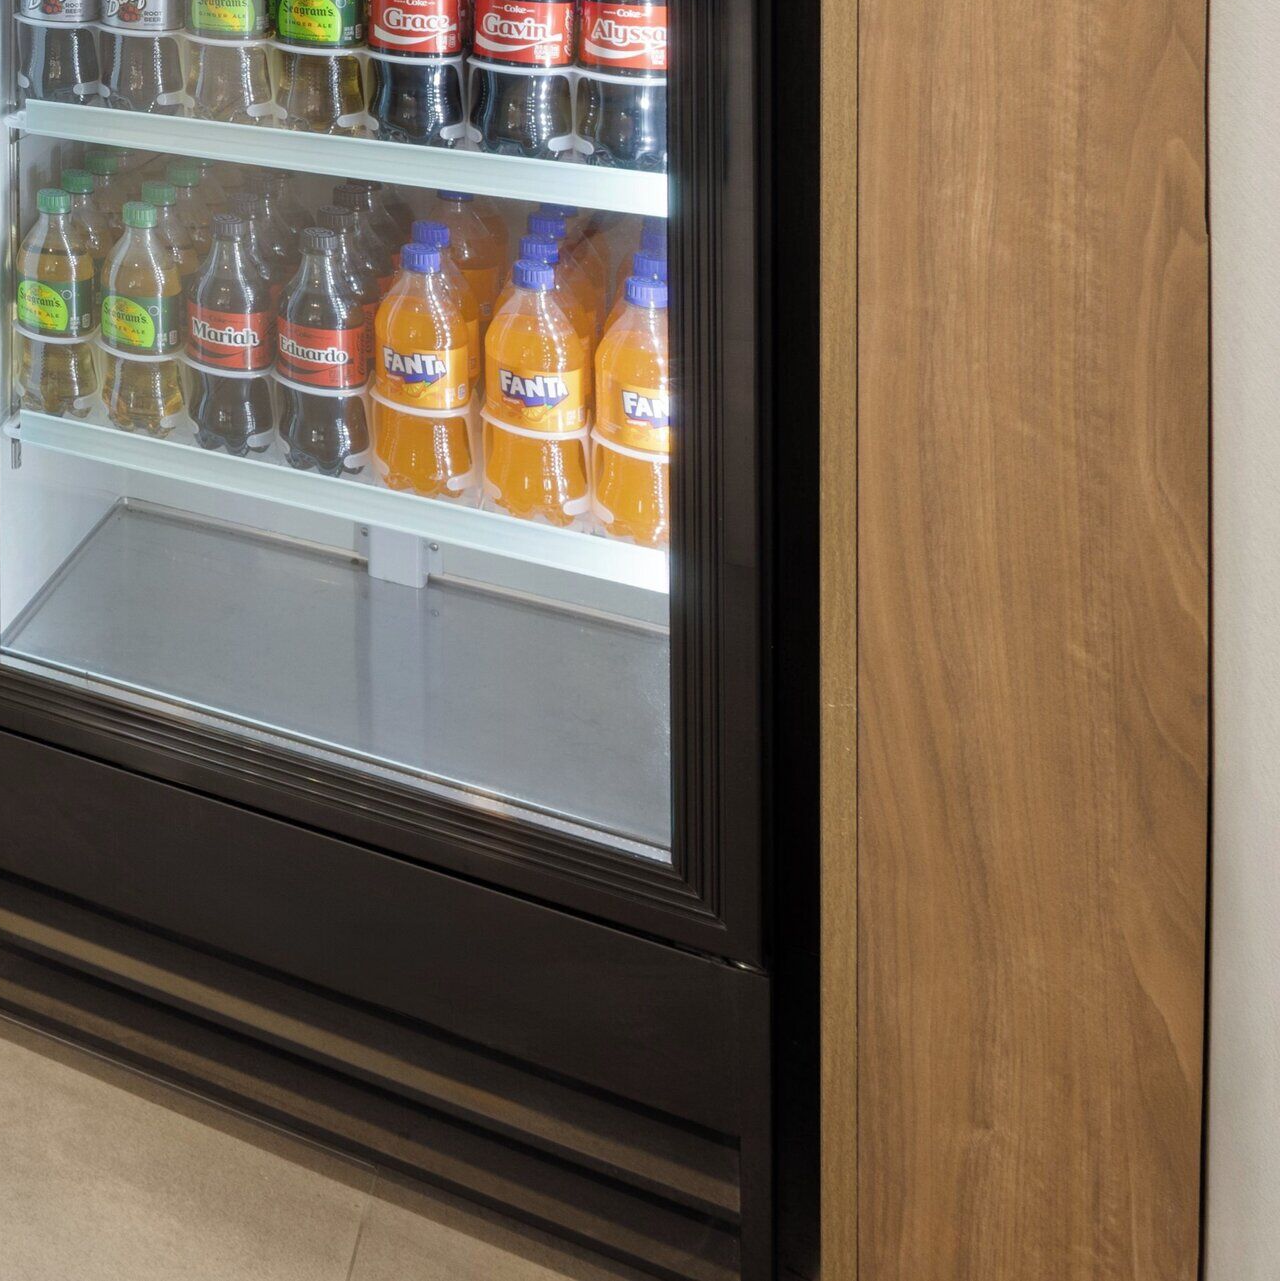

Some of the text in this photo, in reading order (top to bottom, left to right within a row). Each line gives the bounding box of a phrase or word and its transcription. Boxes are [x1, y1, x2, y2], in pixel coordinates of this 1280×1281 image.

[283, 0, 335, 17] Seagram's
[384, 8, 450, 30] Grace
[504, 4, 527, 13] Coke
[617, 8, 640, 18] Coke
[484, 13, 547, 39] Gavin
[593, 18, 666, 46] Alyssa
[193, 319, 258, 345] Mariah
[280, 336, 347, 363] Eduardo
[383, 347, 447, 375] FANTA
[499, 370, 568, 399] FANTA
